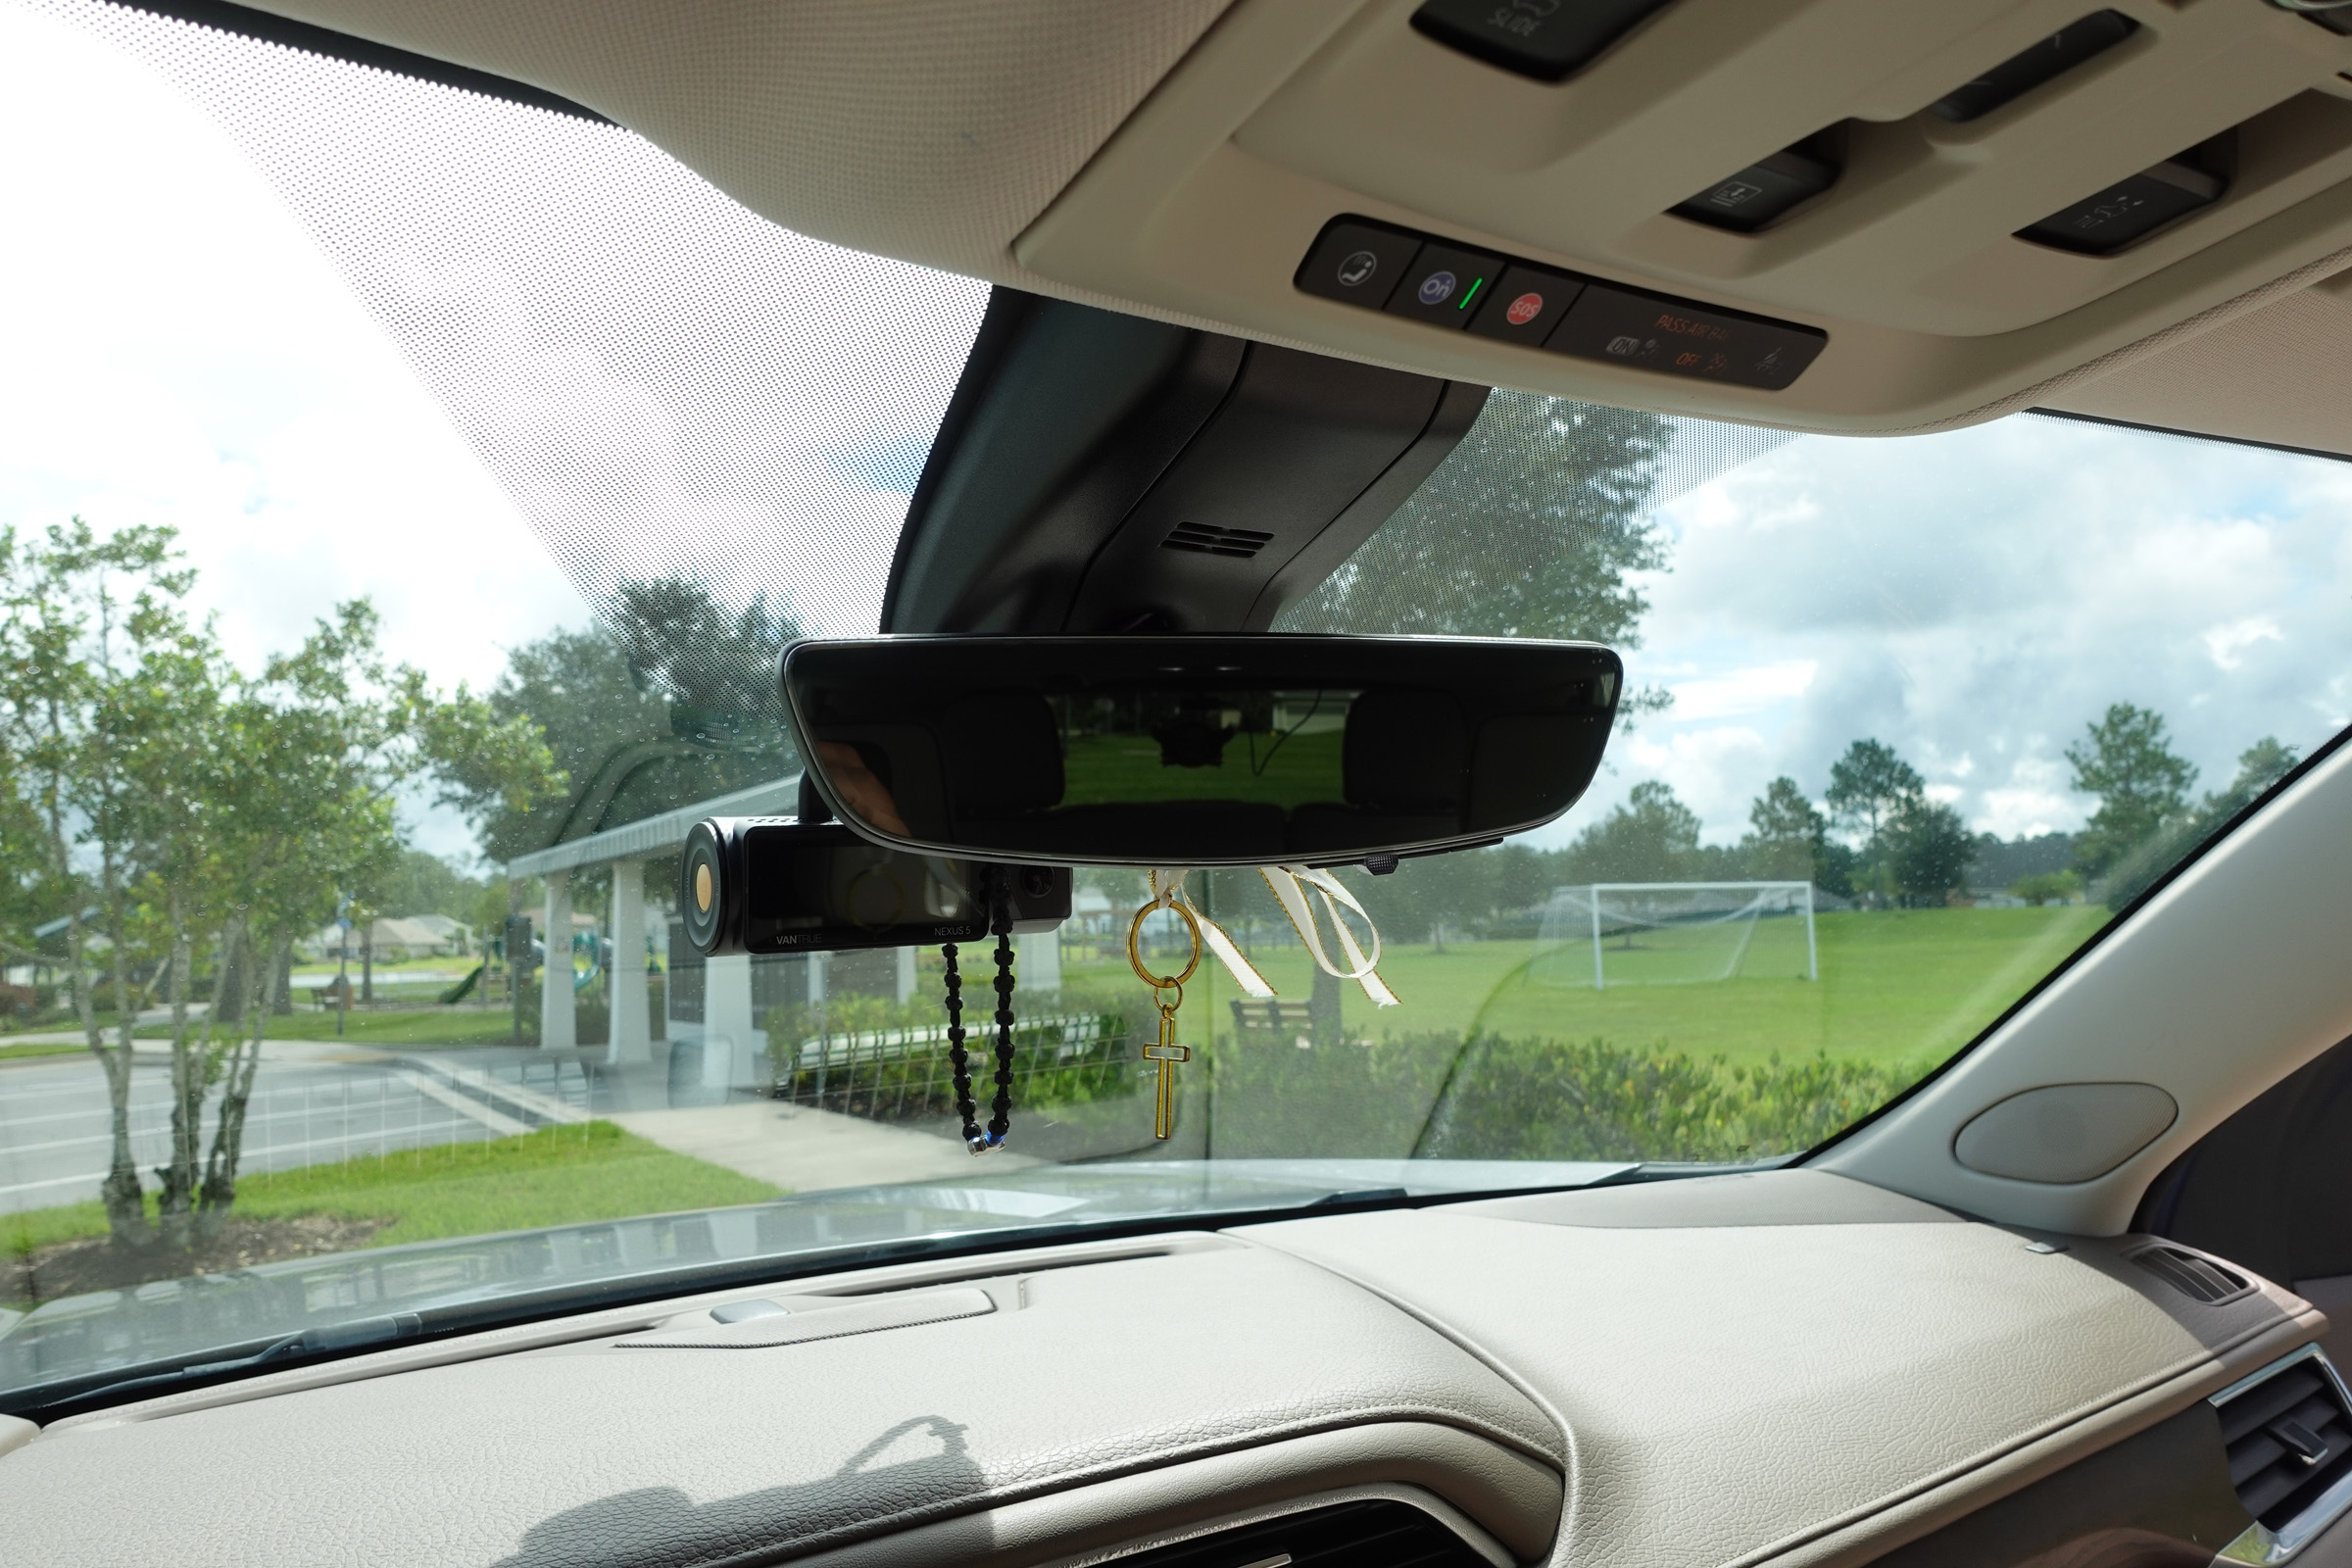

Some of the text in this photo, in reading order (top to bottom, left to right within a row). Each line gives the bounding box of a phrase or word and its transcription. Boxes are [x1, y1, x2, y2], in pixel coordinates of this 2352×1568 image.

[1510, 301, 1540, 318] SOS
[1655, 315, 1690, 333] PASS
[1687, 322, 1710, 337] AIR
[1612, 338, 1636, 353] ON
[1675, 352, 1702, 367] OFF
[934, 925, 972, 937] NEXUS 5
[775, 933, 822, 946] VANTRUE
